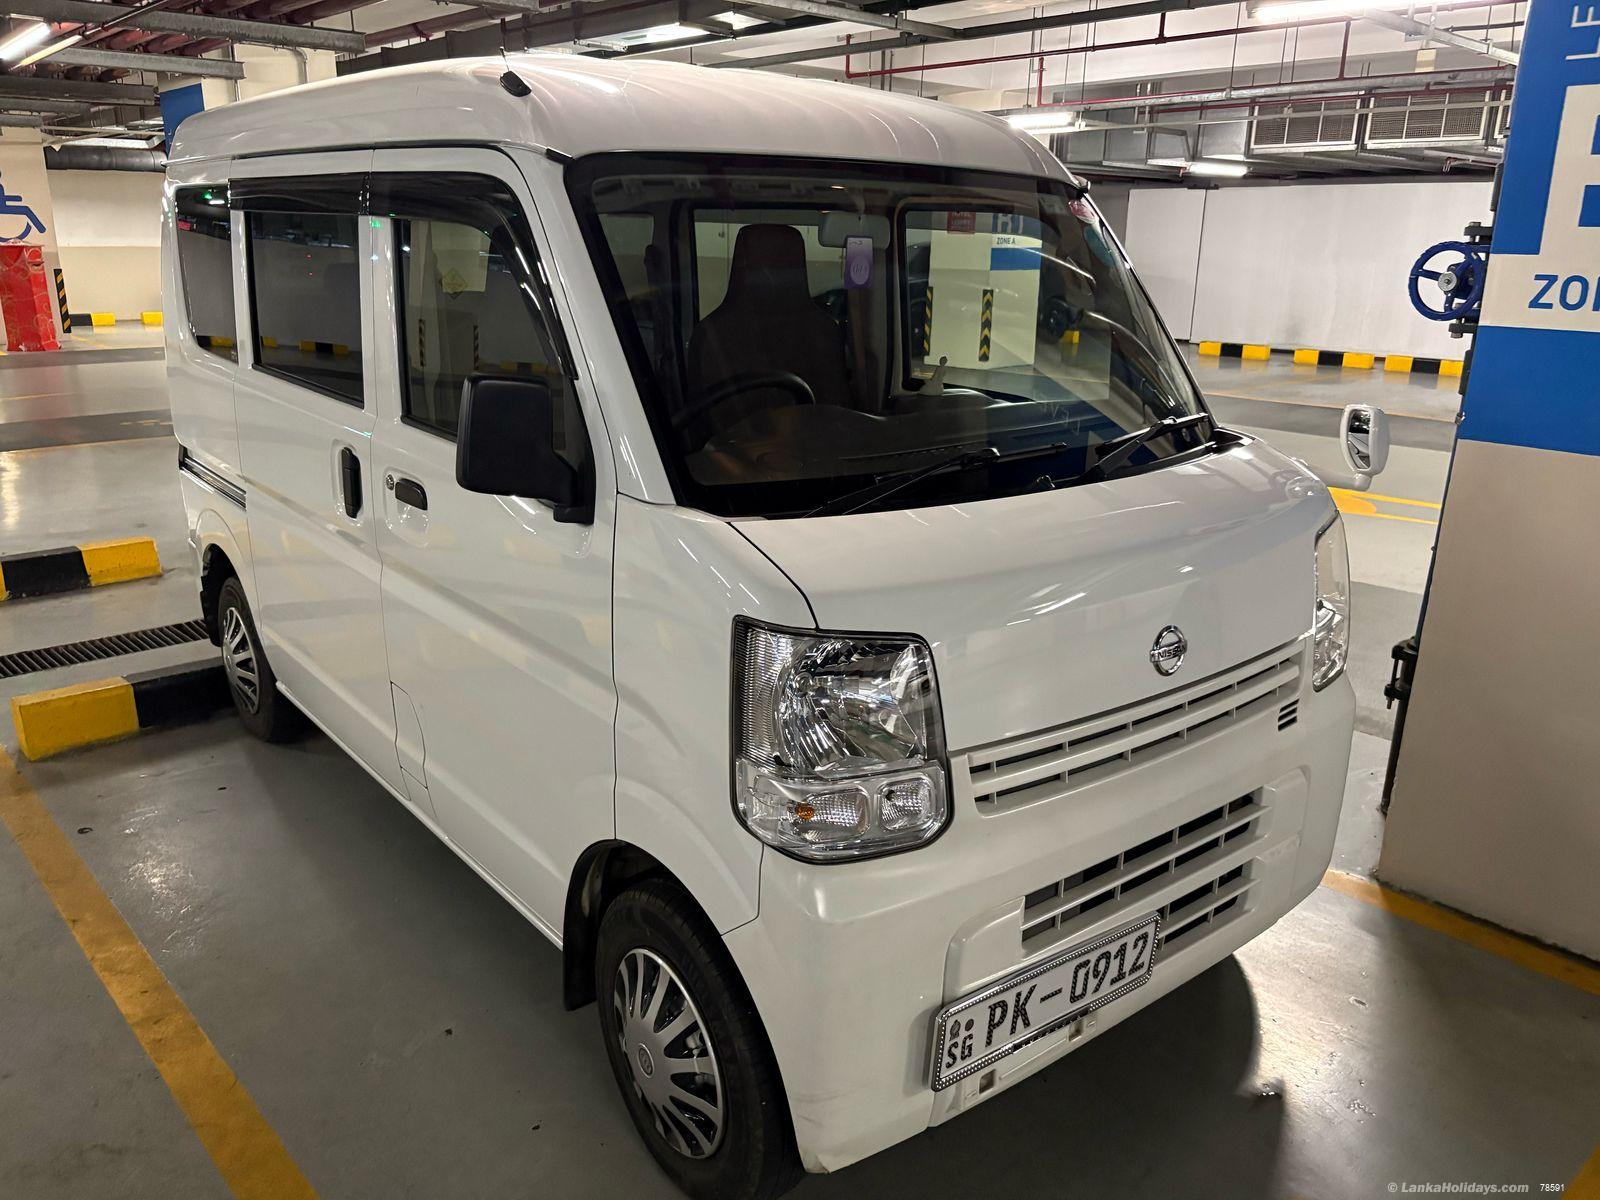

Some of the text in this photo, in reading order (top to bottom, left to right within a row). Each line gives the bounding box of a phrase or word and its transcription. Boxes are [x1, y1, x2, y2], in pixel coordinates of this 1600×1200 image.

[996, 237, 1011, 245] ZONE
[1527, 273, 1600, 312] ZO
[945, 1033, 974, 1069] SG
